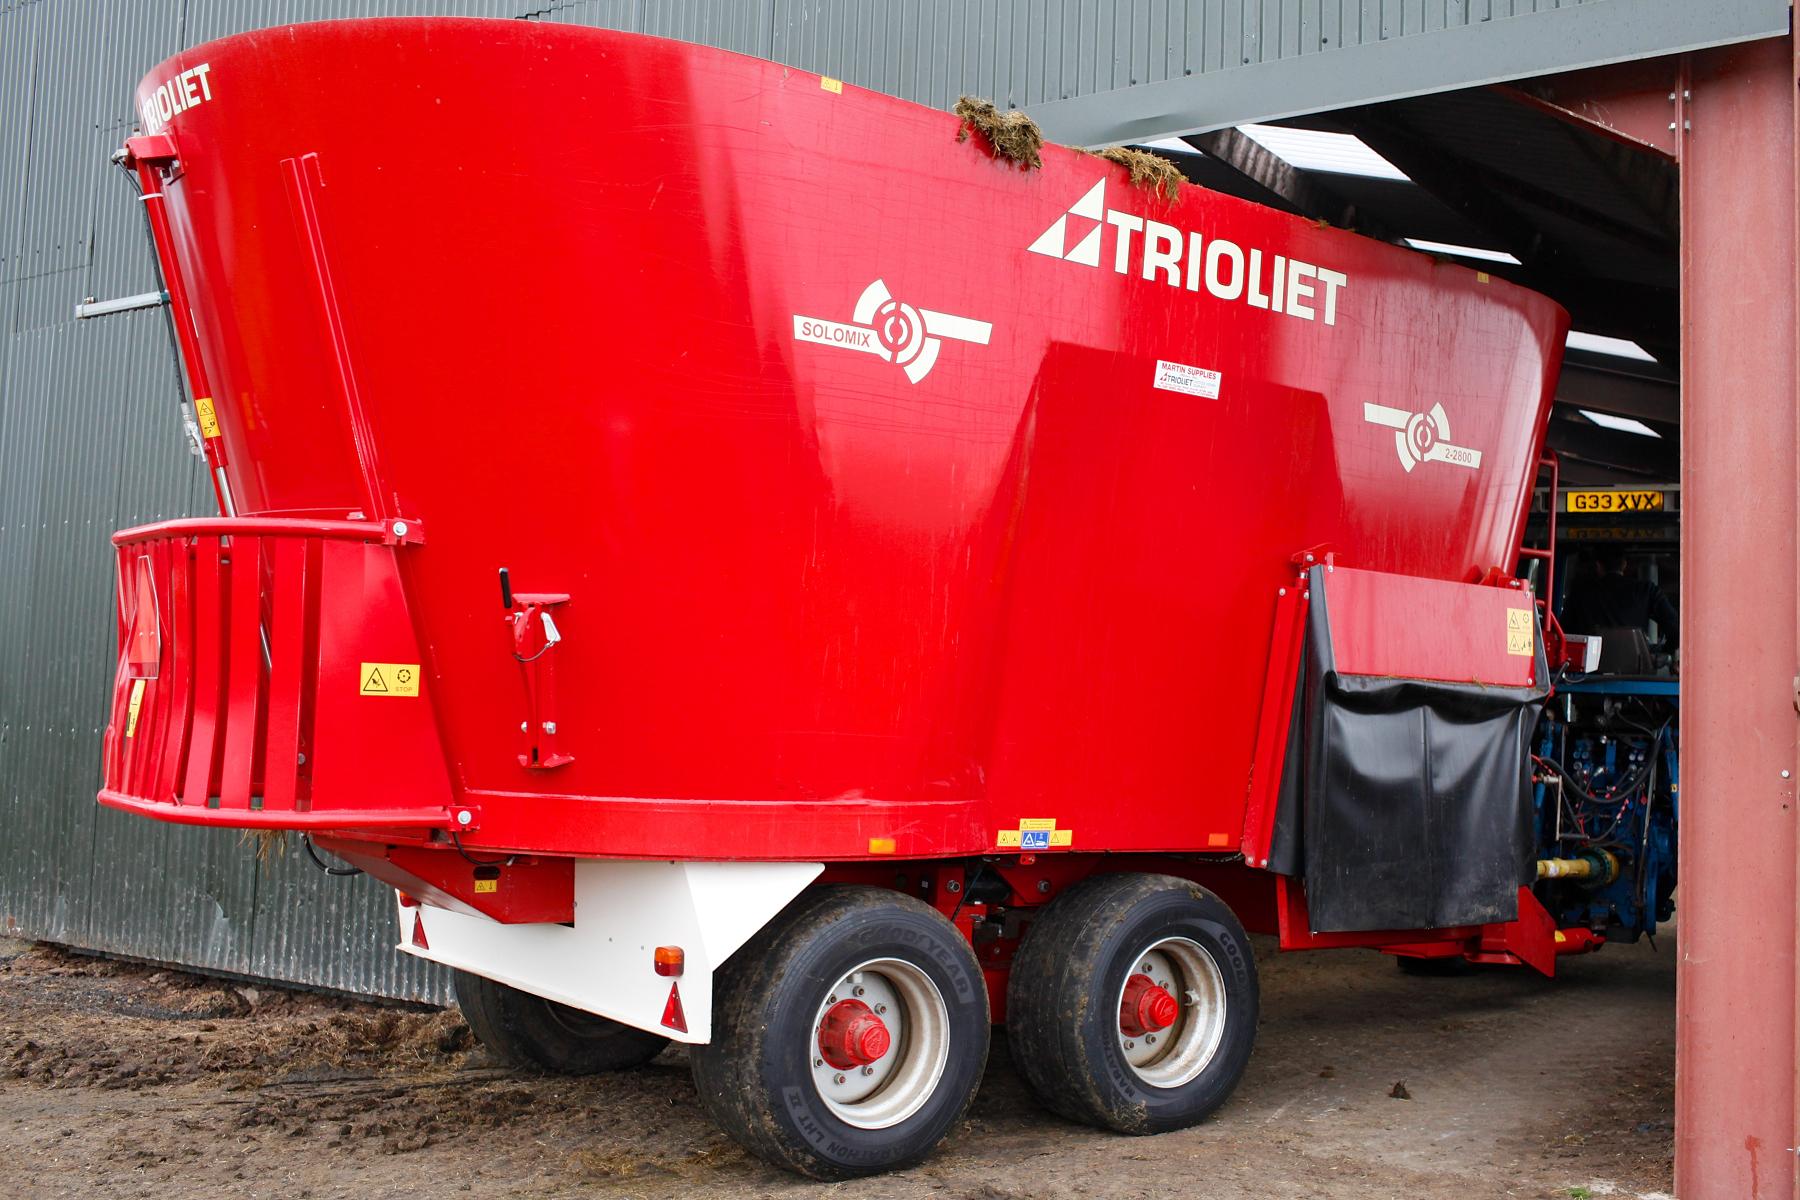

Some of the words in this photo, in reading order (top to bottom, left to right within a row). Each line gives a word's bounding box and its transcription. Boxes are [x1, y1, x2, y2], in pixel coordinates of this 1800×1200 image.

[1107, 209, 1347, 326] TRIOLIET
[802, 322, 870, 347] SOLOMIX
[1162, 363, 1186, 373] MARTIN
[1188, 368, 1217, 380] SUPPLIES
[1167, 375, 1193, 386] TRIOLIET
[1445, 448, 1472, 463] 2-2800
[1575, 494, 1612, 509] G33
[1617, 494, 1656, 510] XVX
[798, 1116, 825, 1143] LHT
[826, 1140, 912, 1162] ARATHON
